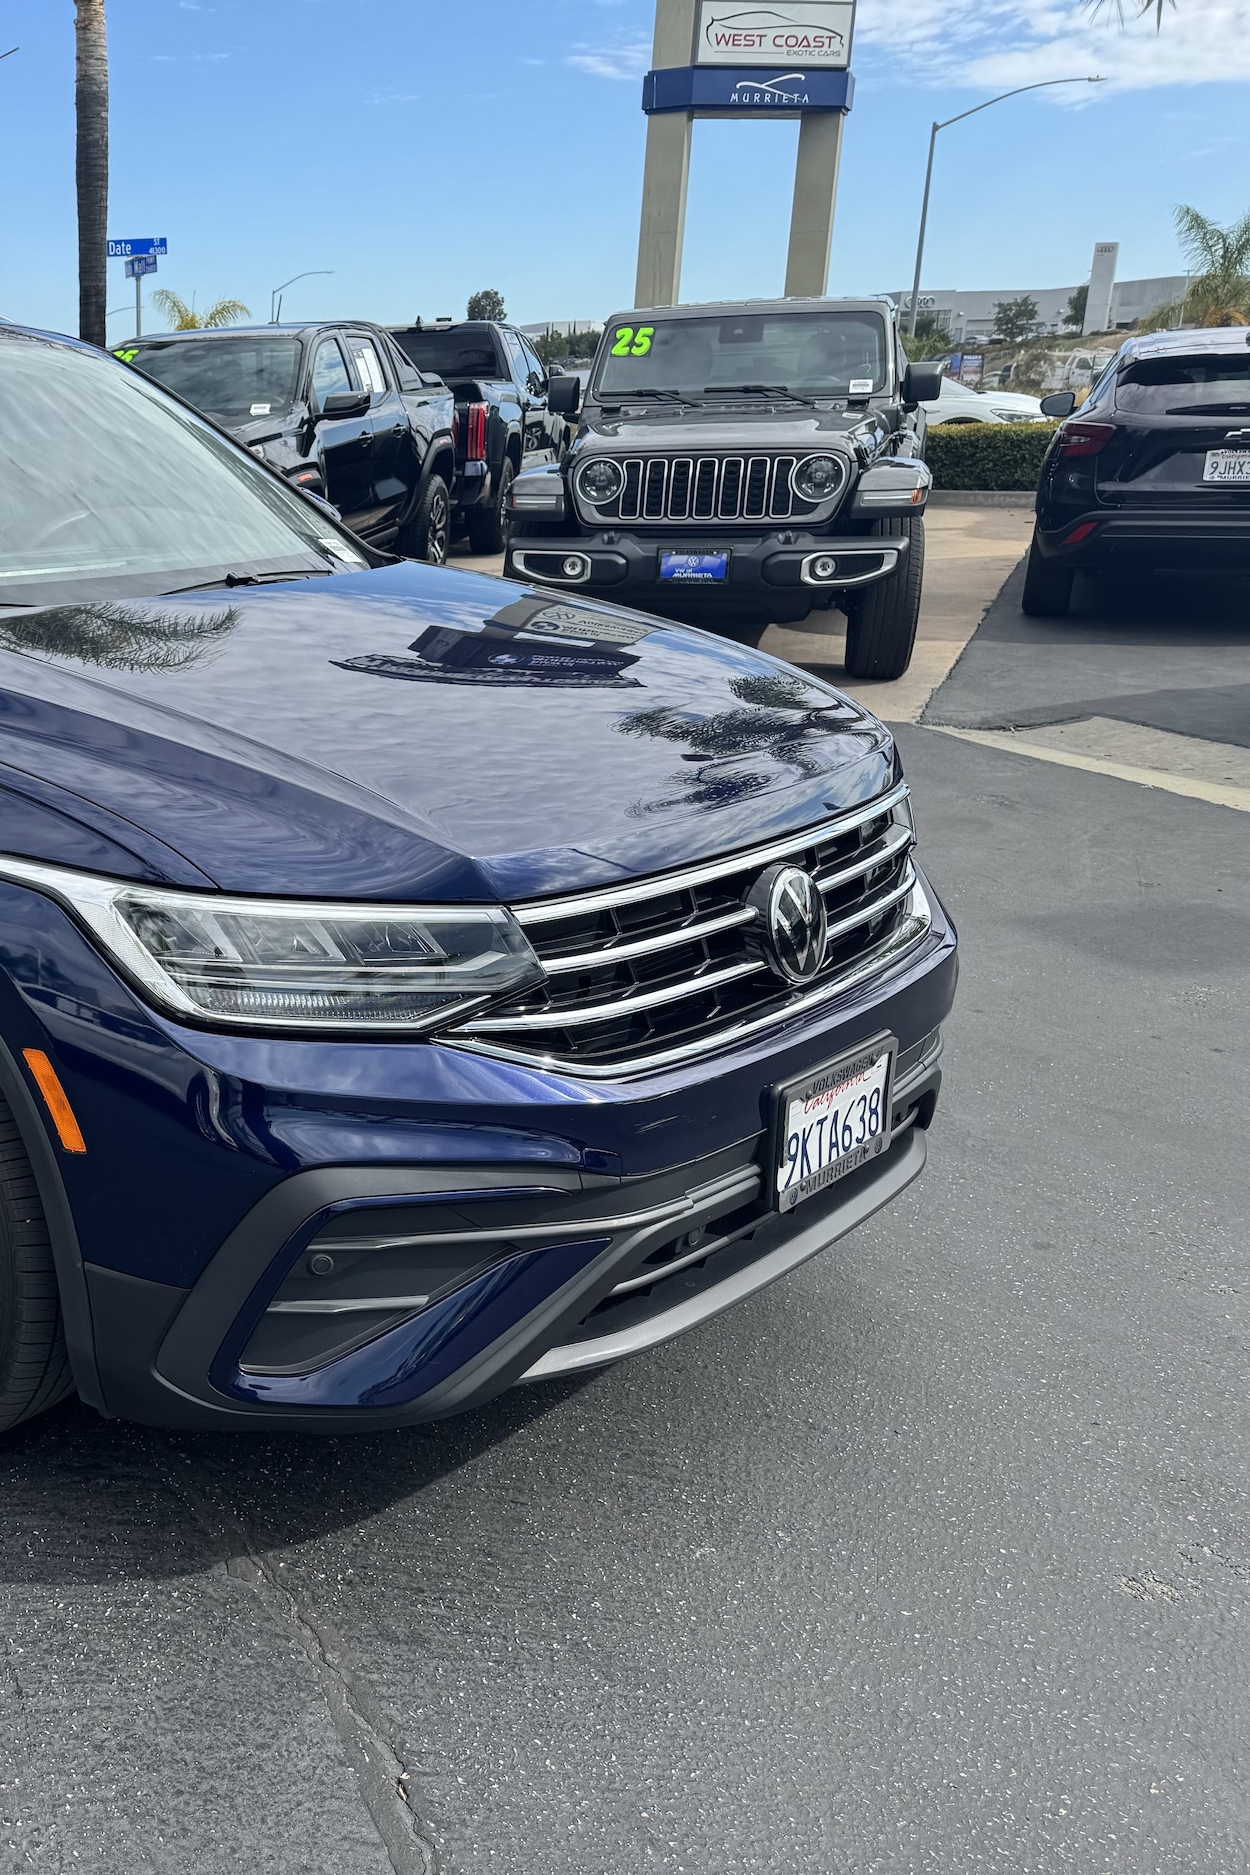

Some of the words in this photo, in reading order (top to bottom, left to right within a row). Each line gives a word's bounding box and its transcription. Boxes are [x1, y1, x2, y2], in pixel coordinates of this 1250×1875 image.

[714, 33, 767, 48] WEST
[772, 34, 837, 49] COAST
[786, 49, 816, 57] EXOTIC
[730, 92, 810, 104] MURRIETA
[108, 241, 132, 256] Date
[153, 238, 160, 246] ST
[611, 327, 655, 356] 25
[812, 1053, 874, 1095] VOLKSWAGEN
[784, 1087, 881, 1189] 9KTA638
[805, 1147, 867, 1195] MURRIETA
